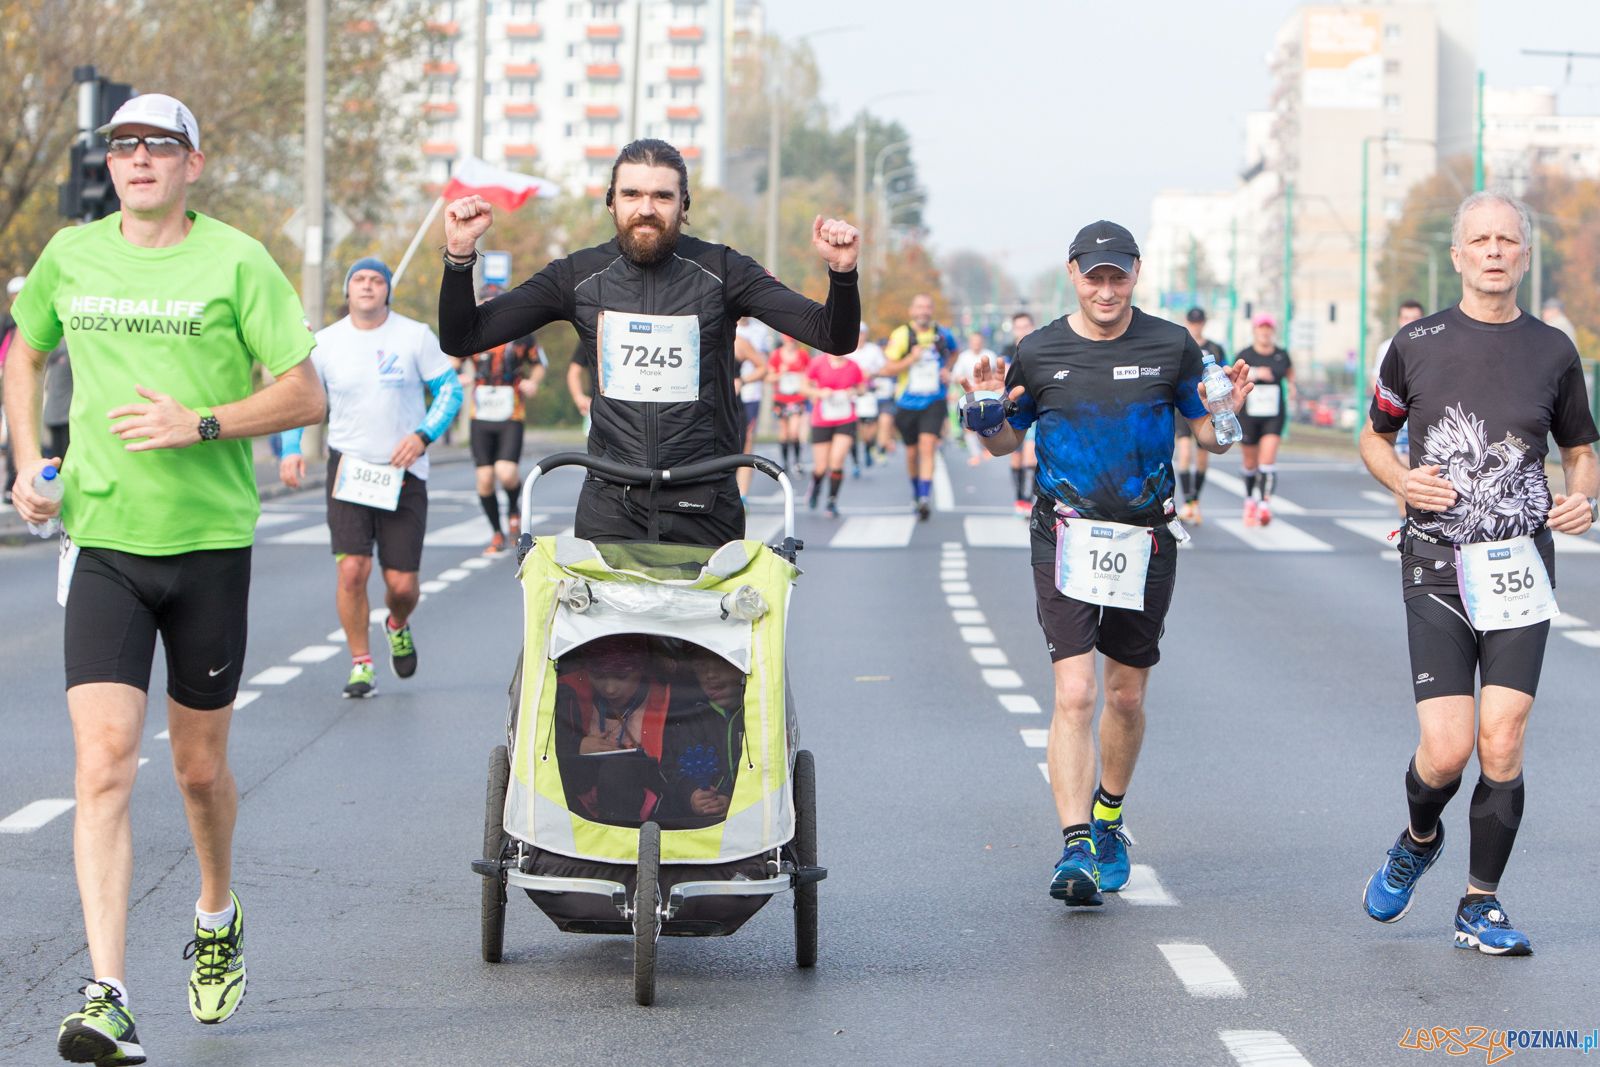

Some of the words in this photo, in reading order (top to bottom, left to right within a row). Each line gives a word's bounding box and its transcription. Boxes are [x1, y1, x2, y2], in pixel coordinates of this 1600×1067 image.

[70, 296, 206, 319] HERBALIFE
[70, 314, 201, 336] ODŻYWIANIE
[620, 344, 682, 369] 7245
[352, 467, 391, 486] 3828
[1089, 550, 1127, 574] 160
[1094, 572, 1120, 581] DARIUSZ
[1490, 567, 1534, 595] 356
[1503, 593, 1530, 602] Tomasz
